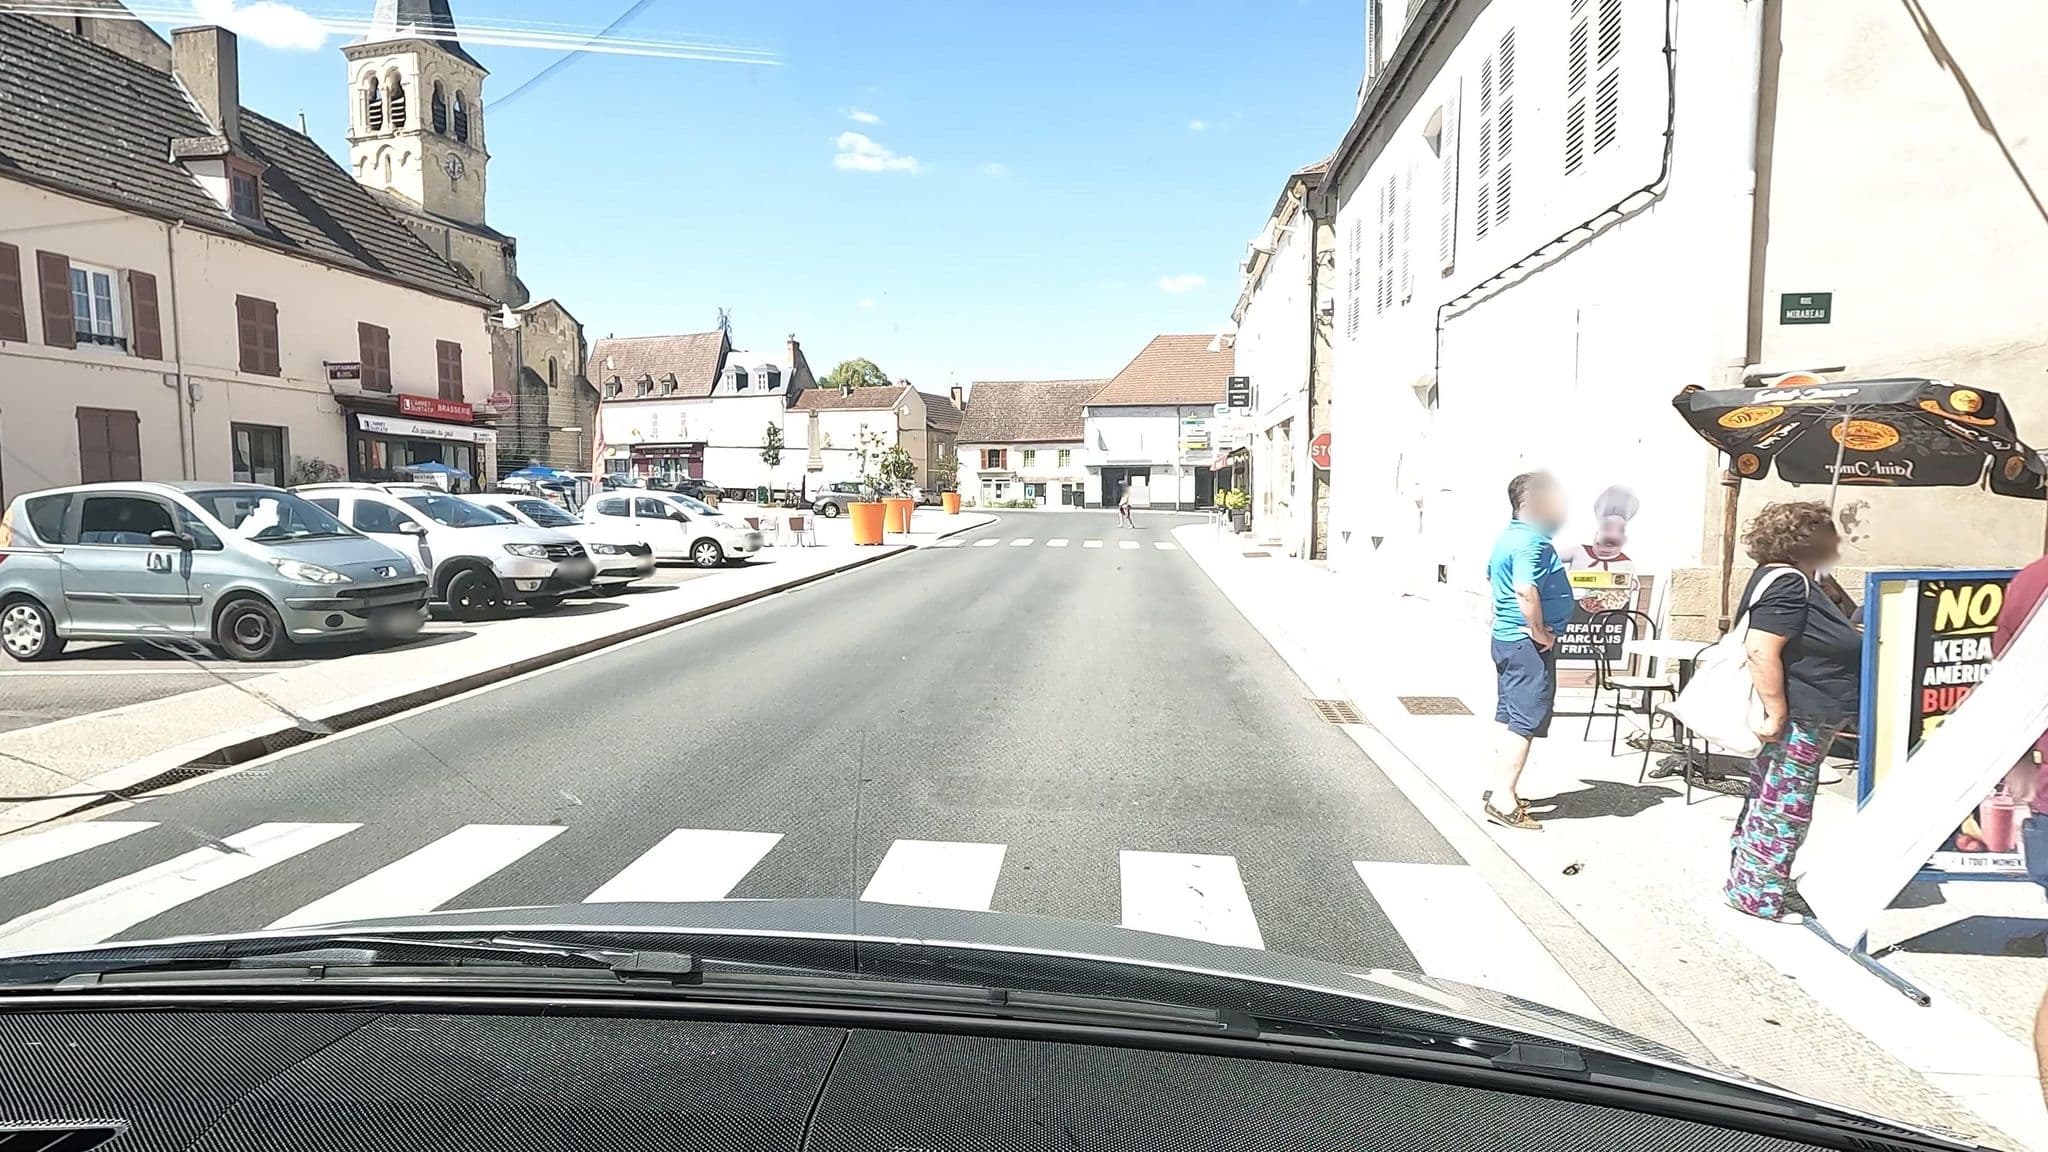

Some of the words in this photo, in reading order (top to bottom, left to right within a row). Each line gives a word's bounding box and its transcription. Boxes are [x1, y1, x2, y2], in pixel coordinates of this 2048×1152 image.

[1786, 309, 1825, 319] MIRABEAU
[437, 403, 471, 415] BRASSERIE
[1934, 583, 2003, 631] NO
[1566, 623, 1602, 633] RFAIT
[1605, 624, 1623, 633] DE
[1933, 637, 1994, 664] KEBA
[1992, 858, 2022, 866] MOMEN
